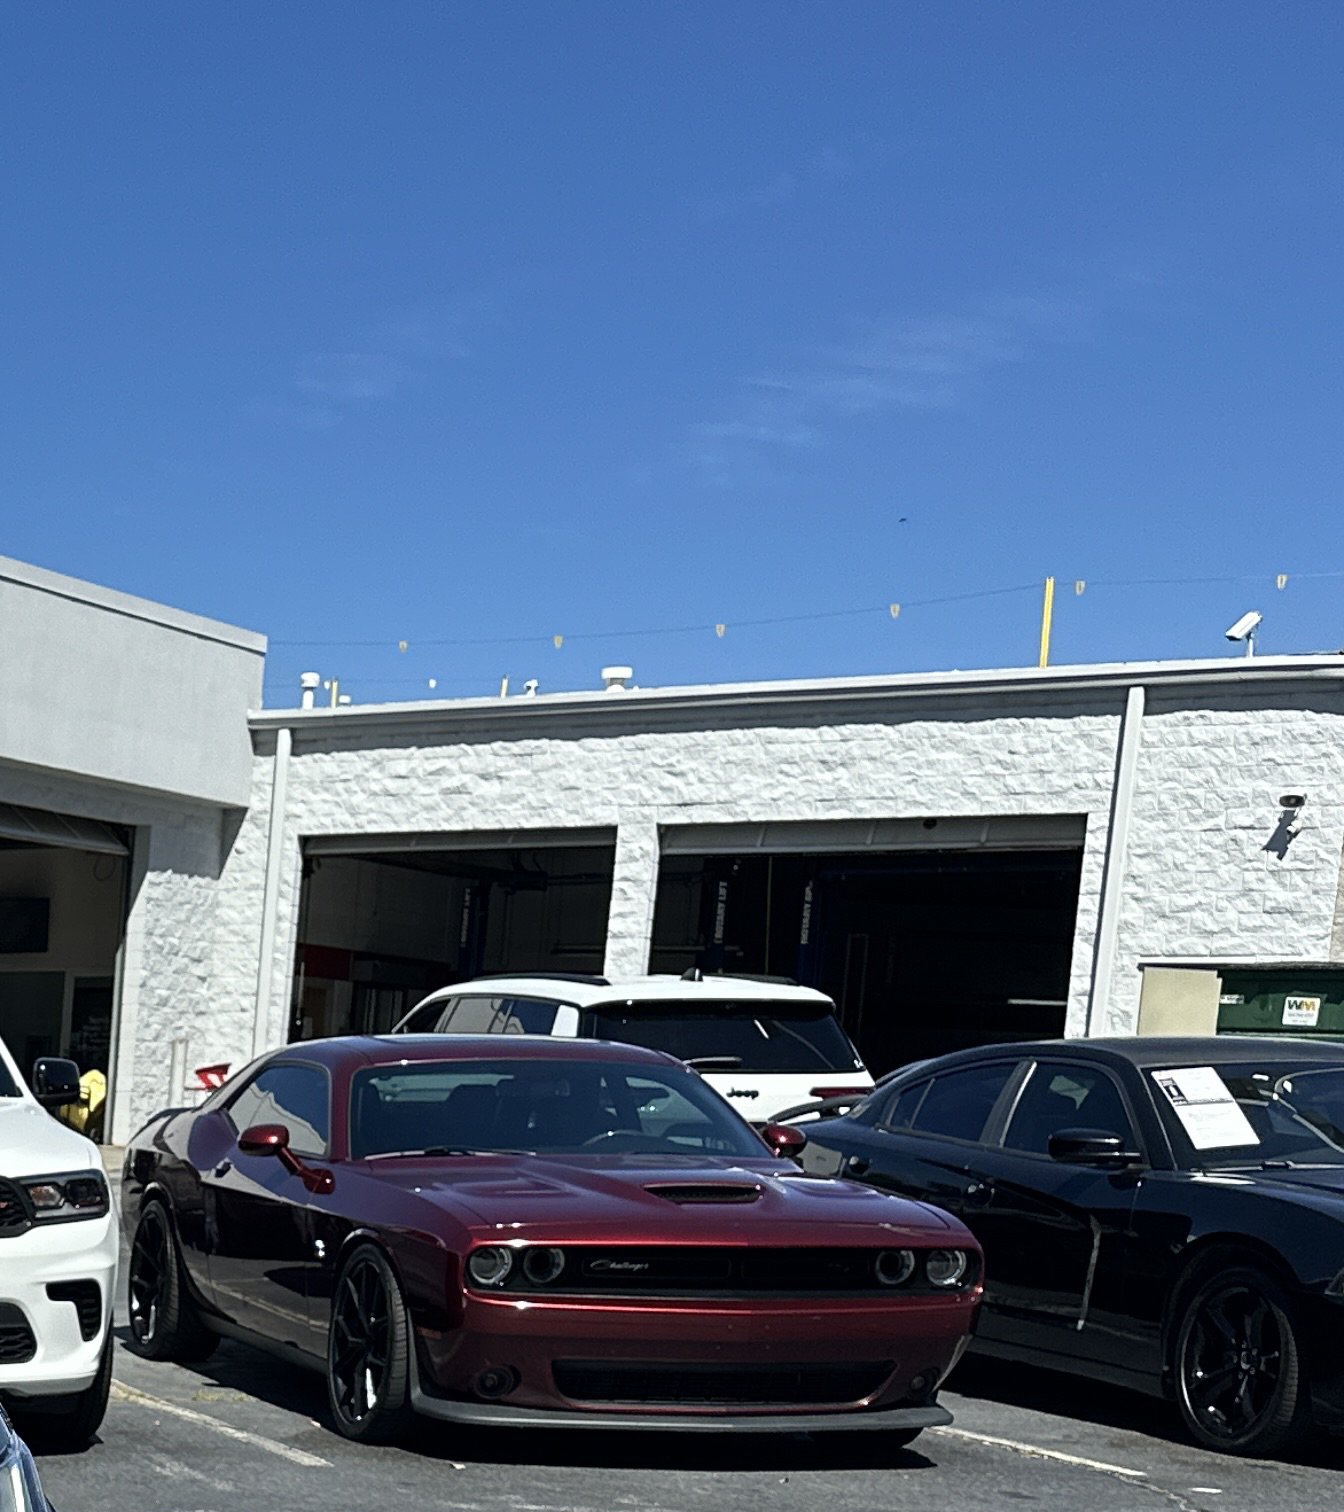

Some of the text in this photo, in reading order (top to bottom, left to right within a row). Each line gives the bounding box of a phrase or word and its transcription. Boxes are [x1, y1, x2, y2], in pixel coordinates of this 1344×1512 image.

[714, 881, 728, 938] ROTARY LIFT
[1288, 1000, 1316, 1011] WM
[726, 1087, 760, 1100] Jeep
